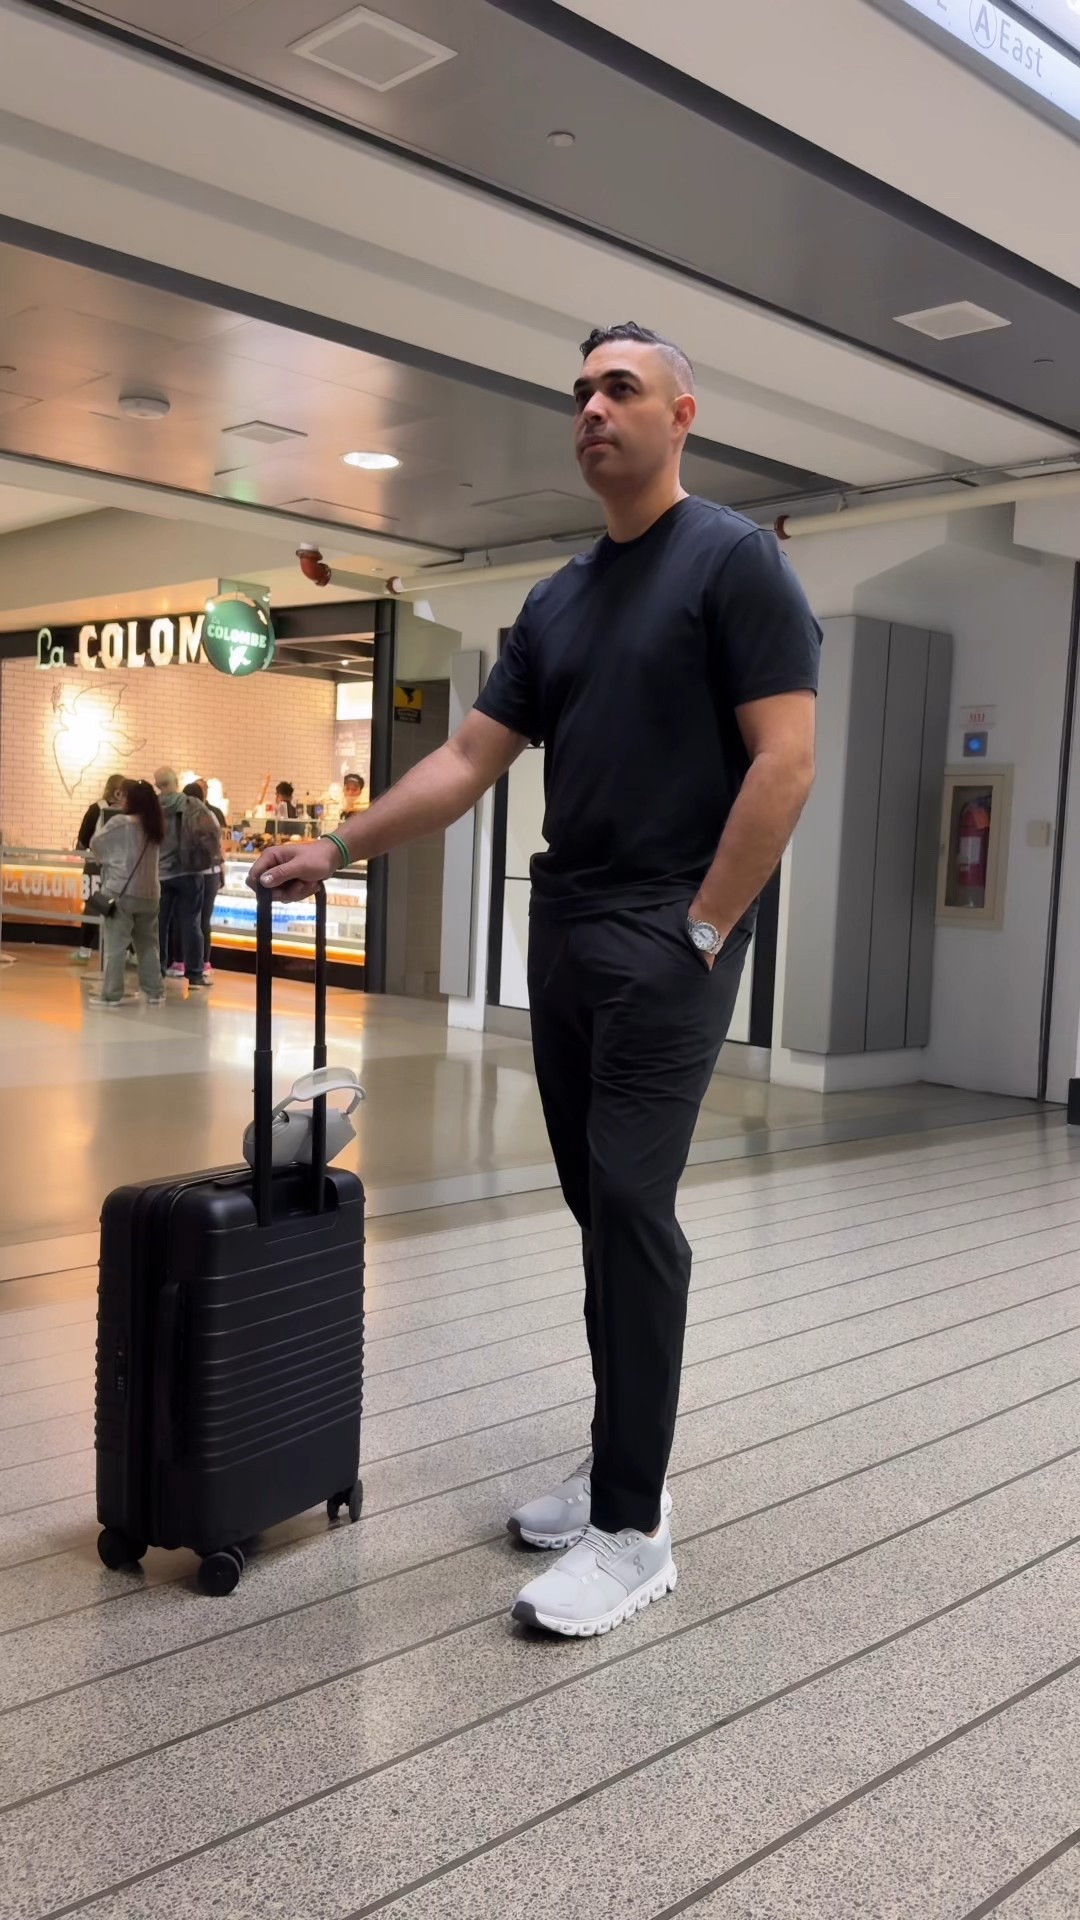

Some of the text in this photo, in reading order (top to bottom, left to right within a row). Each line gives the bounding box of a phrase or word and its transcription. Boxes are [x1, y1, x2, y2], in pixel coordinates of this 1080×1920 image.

[1000, 18, 1044, 78] East
[36, 627, 67, 670] La
[206, 623, 267, 649] COLOMBE
